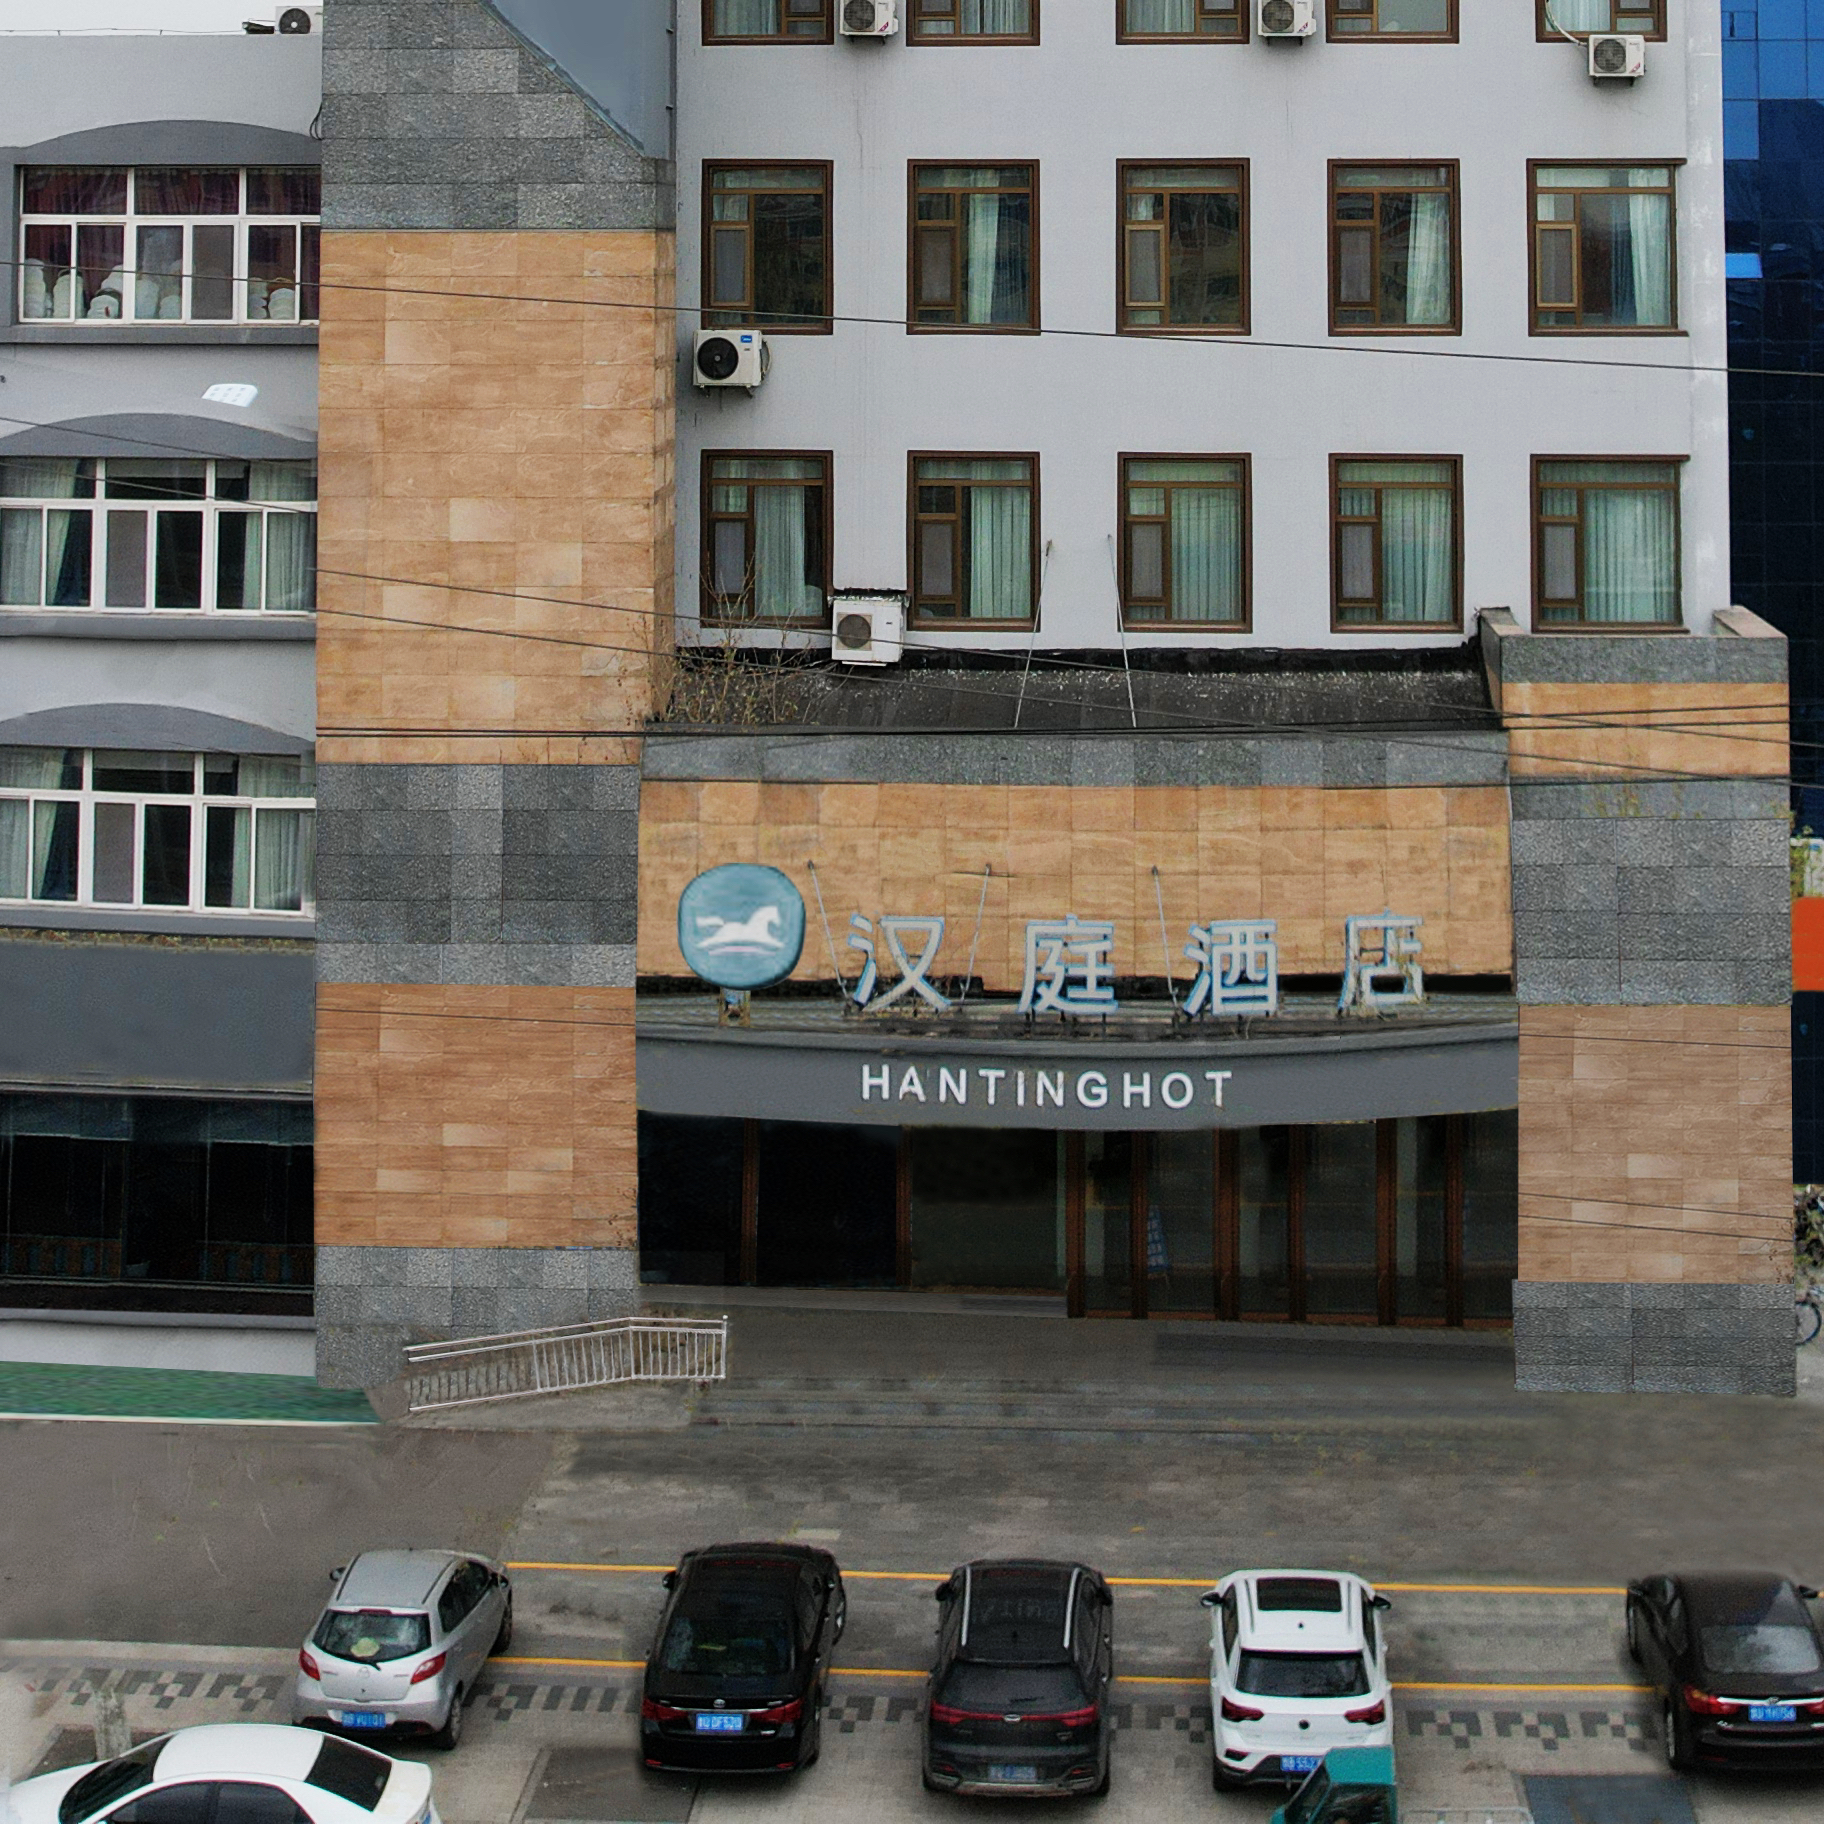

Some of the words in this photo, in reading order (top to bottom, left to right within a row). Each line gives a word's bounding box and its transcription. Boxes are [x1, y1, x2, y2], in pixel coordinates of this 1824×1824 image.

[845, 908, 1426, 1018] 汉庭酒店
[860, 1062, 1235, 1110] HANTINGHOT
